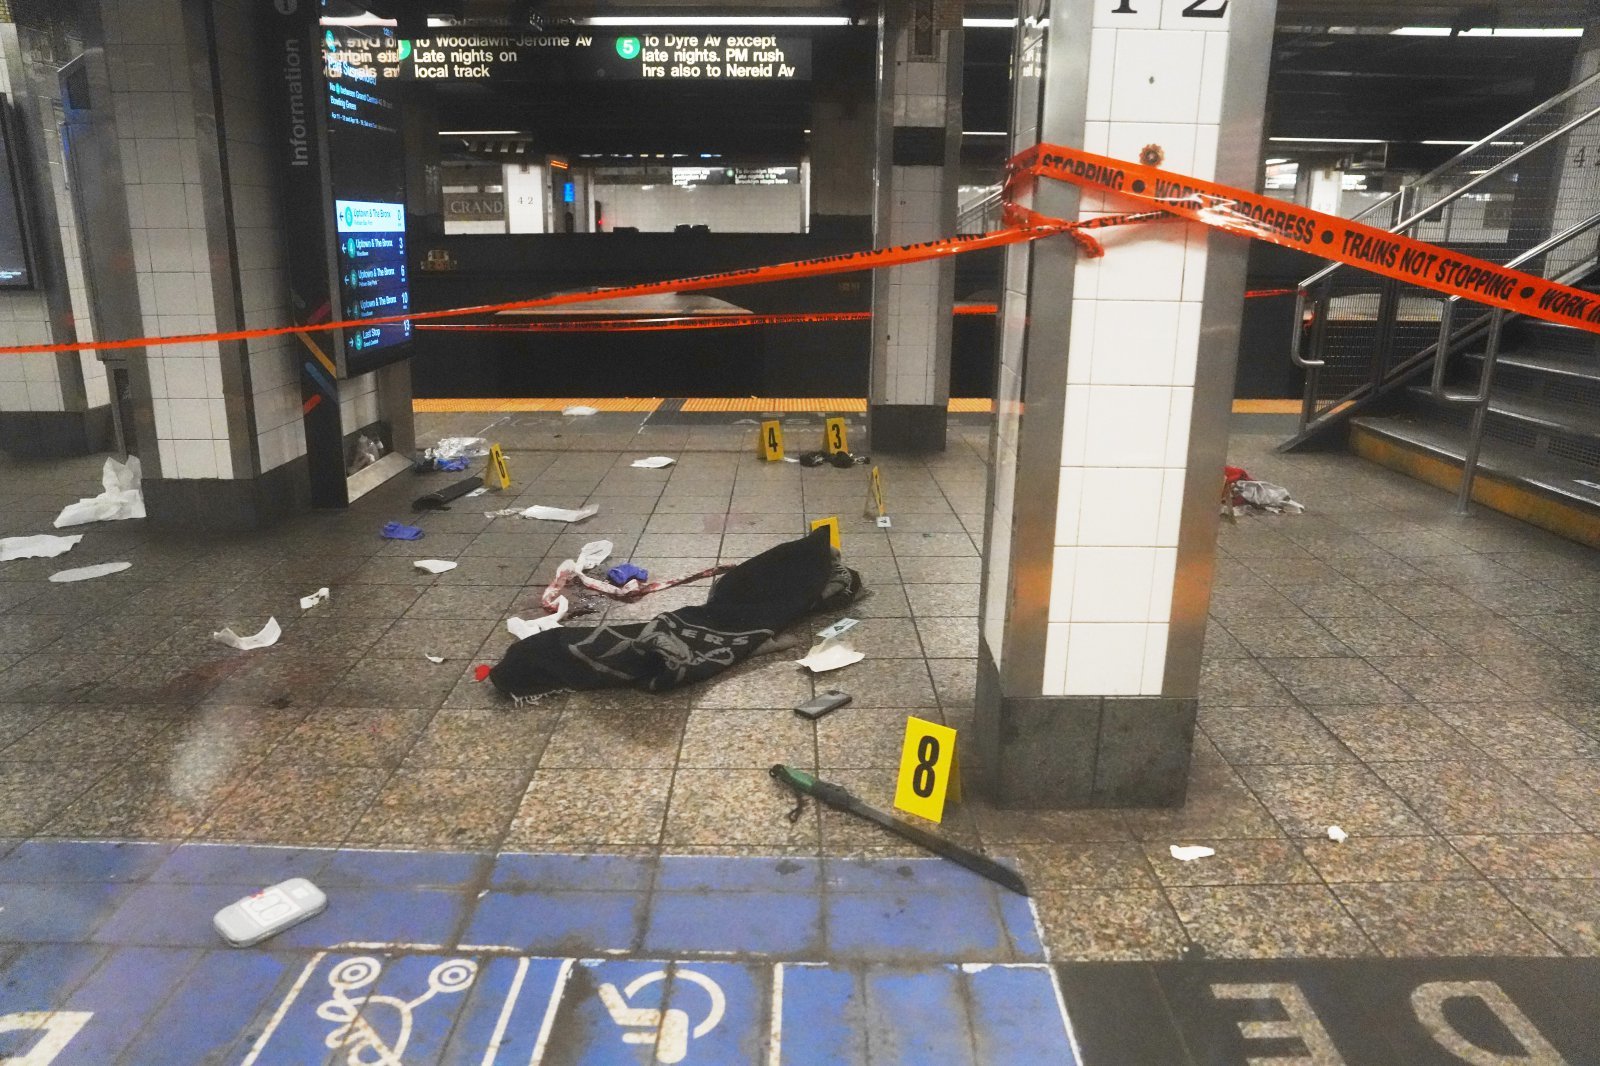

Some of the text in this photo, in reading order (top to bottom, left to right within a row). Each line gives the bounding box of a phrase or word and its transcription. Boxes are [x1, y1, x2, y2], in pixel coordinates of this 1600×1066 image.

[436, 34, 570, 47] Woodlawn-Jerome
[576, 35, 592, 47] Av
[622, 34, 777, 54] 5 To Dyre Av except
[413, 49, 517, 66] Late nights on
[642, 48, 785, 65] late nights. PM rush
[414, 64, 490, 78] local track
[642, 63, 796, 77] hrs also to Nereid Av
[284, 39, 309, 166] Information
[450, 200, 504, 214] GRAND
[355, 239, 371, 250] Uptown
[382, 238, 394, 248] Bronx
[399, 236, 404, 249] 3
[358, 269, 374, 280] Uptown
[384, 266, 395, 276] Bronx
[400, 264, 406, 277] 6
[1342, 229, 1519, 301] TRAINS NOT STOPPING
[360, 300, 376, 311] Uptown
[386, 295, 397, 305] Bronx
[401, 291, 409, 304] 10
[1537, 287, 1590, 321] WORK
[363, 330, 372, 340] Last
[371, 328, 381, 338] Stop
[403, 319, 411, 332] 13
[768, 427, 778, 452] 4
[831, 423, 842, 450] 3
[495, 450, 506, 479] 6
[912, 735, 940, 799] 8
